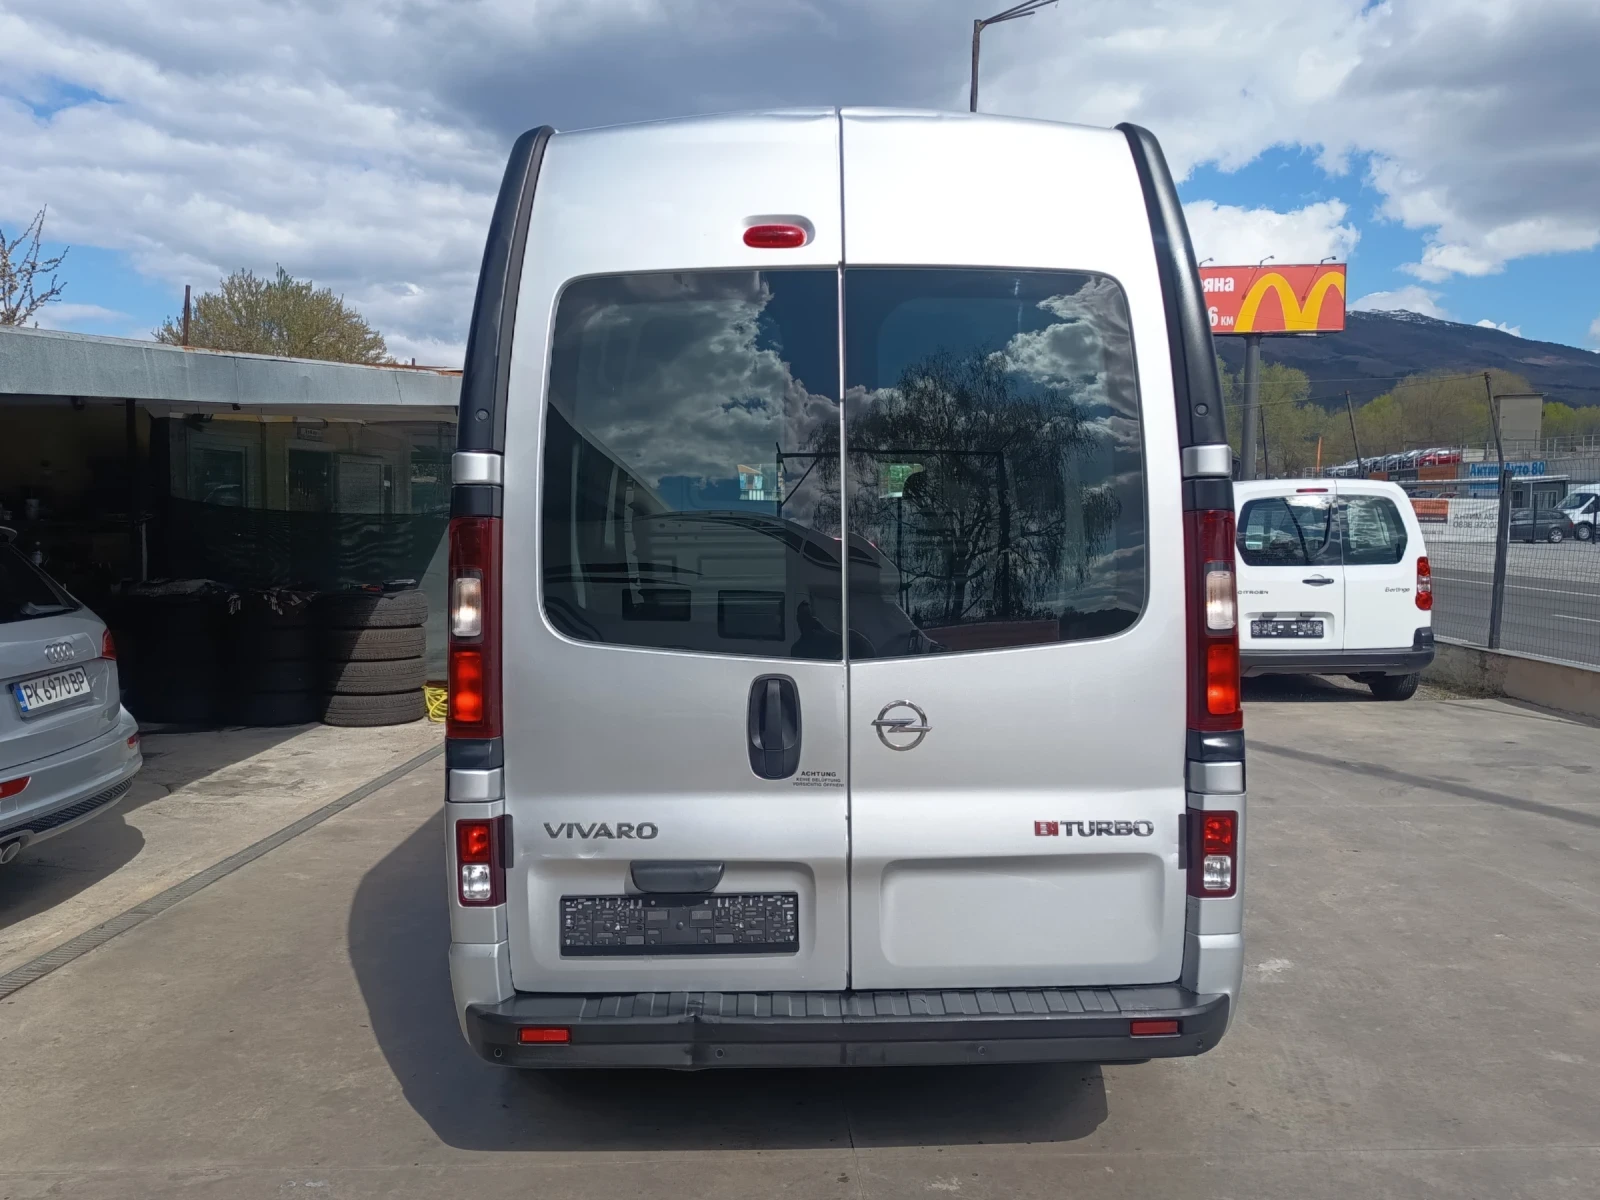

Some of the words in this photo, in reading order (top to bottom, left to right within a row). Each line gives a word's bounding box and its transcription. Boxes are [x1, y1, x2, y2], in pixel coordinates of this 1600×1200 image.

[1200, 277, 1235, 292] яна
[1532, 461, 1545, 476] 80
[23, 682, 44, 706] PK
[43, 675, 72, 701] 6970
[68, 671, 84, 693] BP
[543, 822, 659, 840] VIVARO
